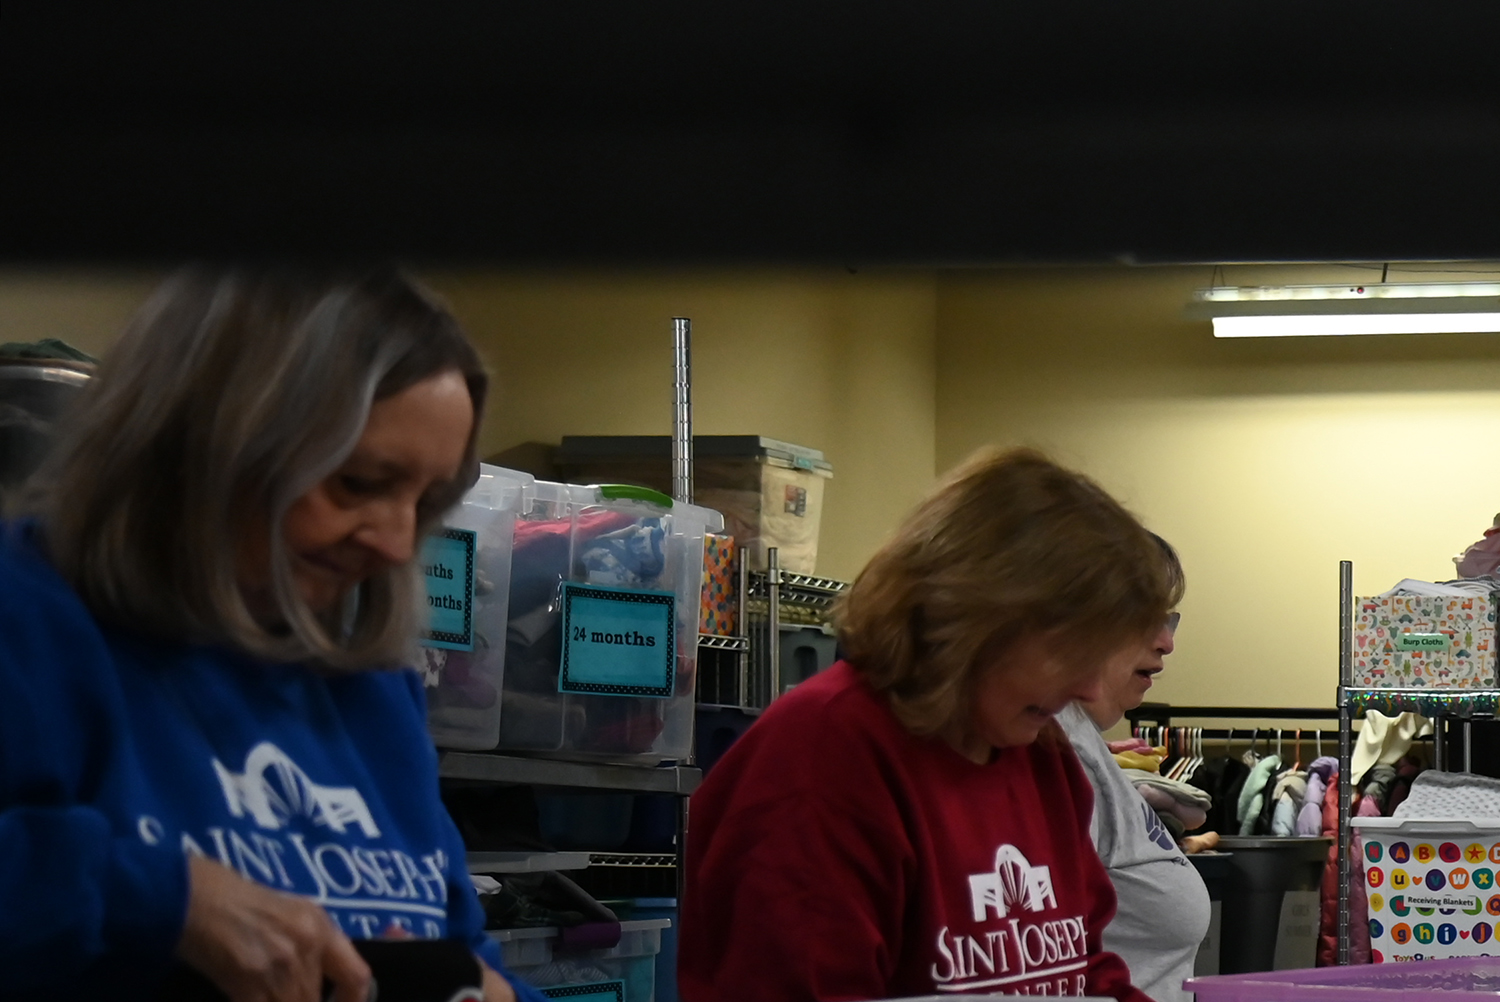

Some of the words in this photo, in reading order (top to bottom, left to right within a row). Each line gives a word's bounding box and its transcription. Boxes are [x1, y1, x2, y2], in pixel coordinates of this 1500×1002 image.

[573, 626, 587, 641] 24
[591, 630, 656, 647] months
[1403, 637, 1420, 647] Burp
[1421, 637, 1444, 646] Cloths
[1408, 896, 1442, 906] Receiving
[1443, 898, 1474, 907] Blankets
